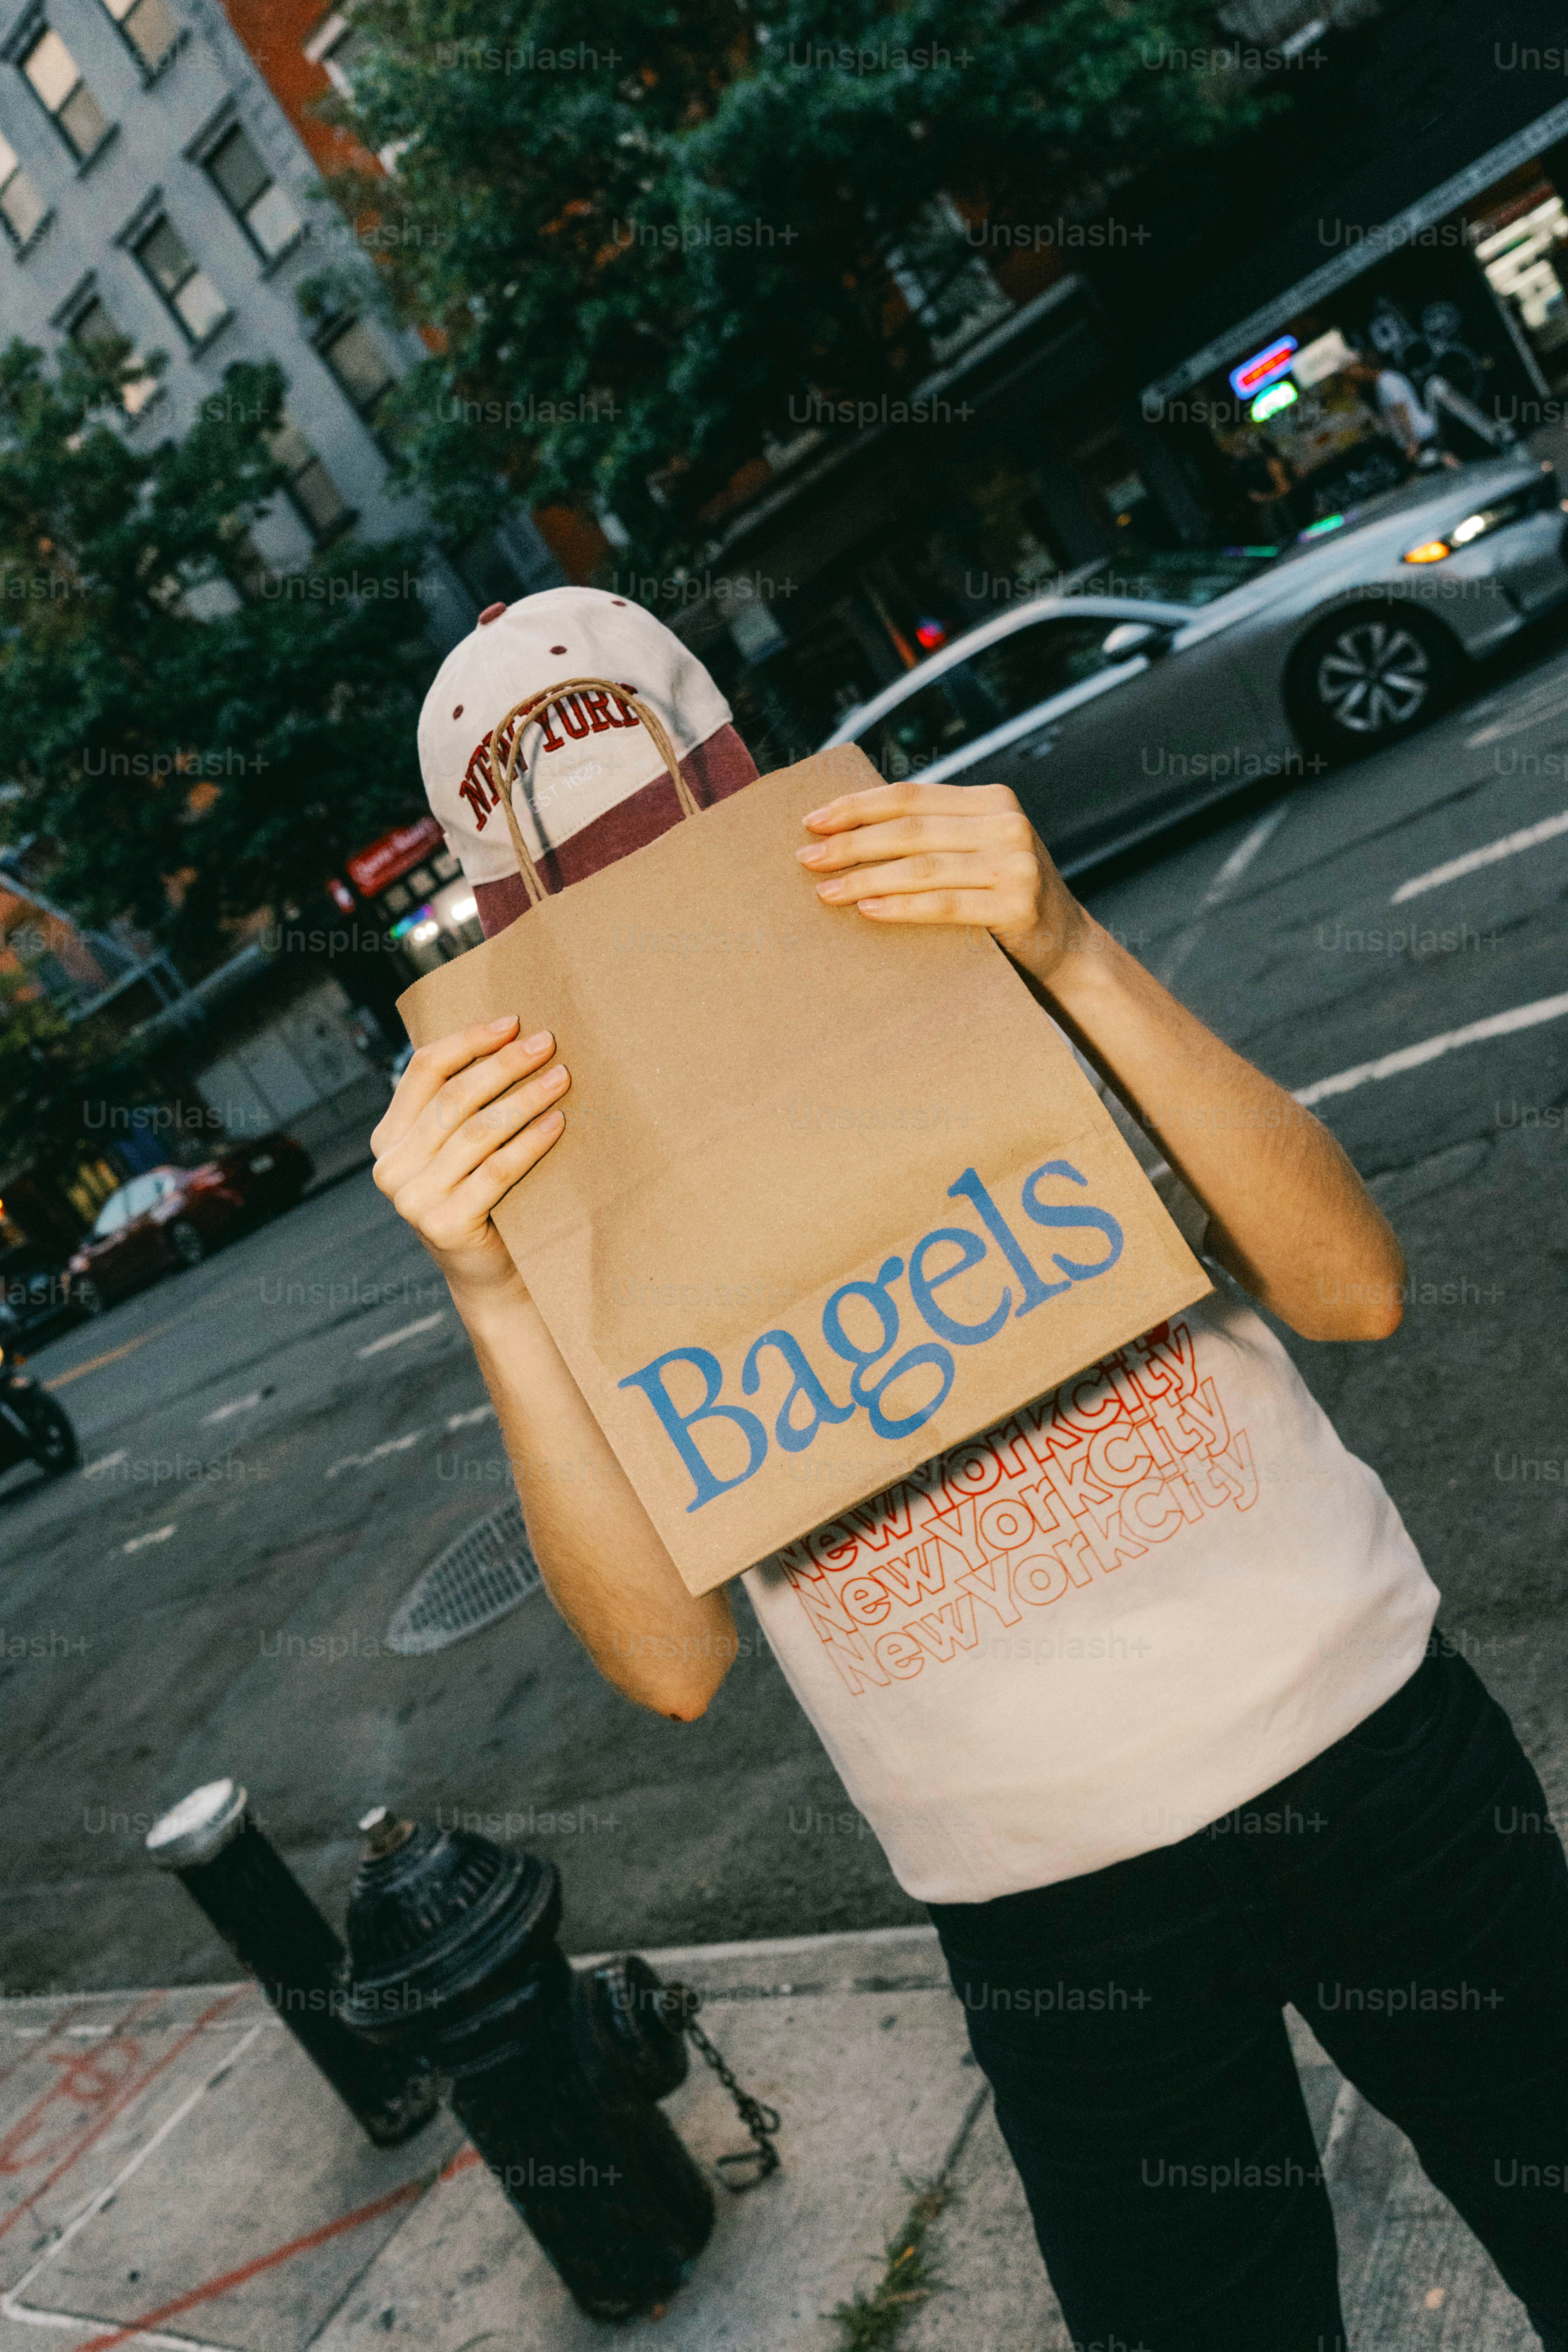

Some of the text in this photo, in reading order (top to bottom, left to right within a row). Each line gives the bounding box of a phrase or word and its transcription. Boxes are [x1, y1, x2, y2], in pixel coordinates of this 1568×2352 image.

[526, 784, 559, 814] EST
[618, 1159, 1124, 1514] Bagels
[791, 1376, 1230, 1642] NewYorkCity
[823, 1429, 1259, 1696] NewYorkCity
